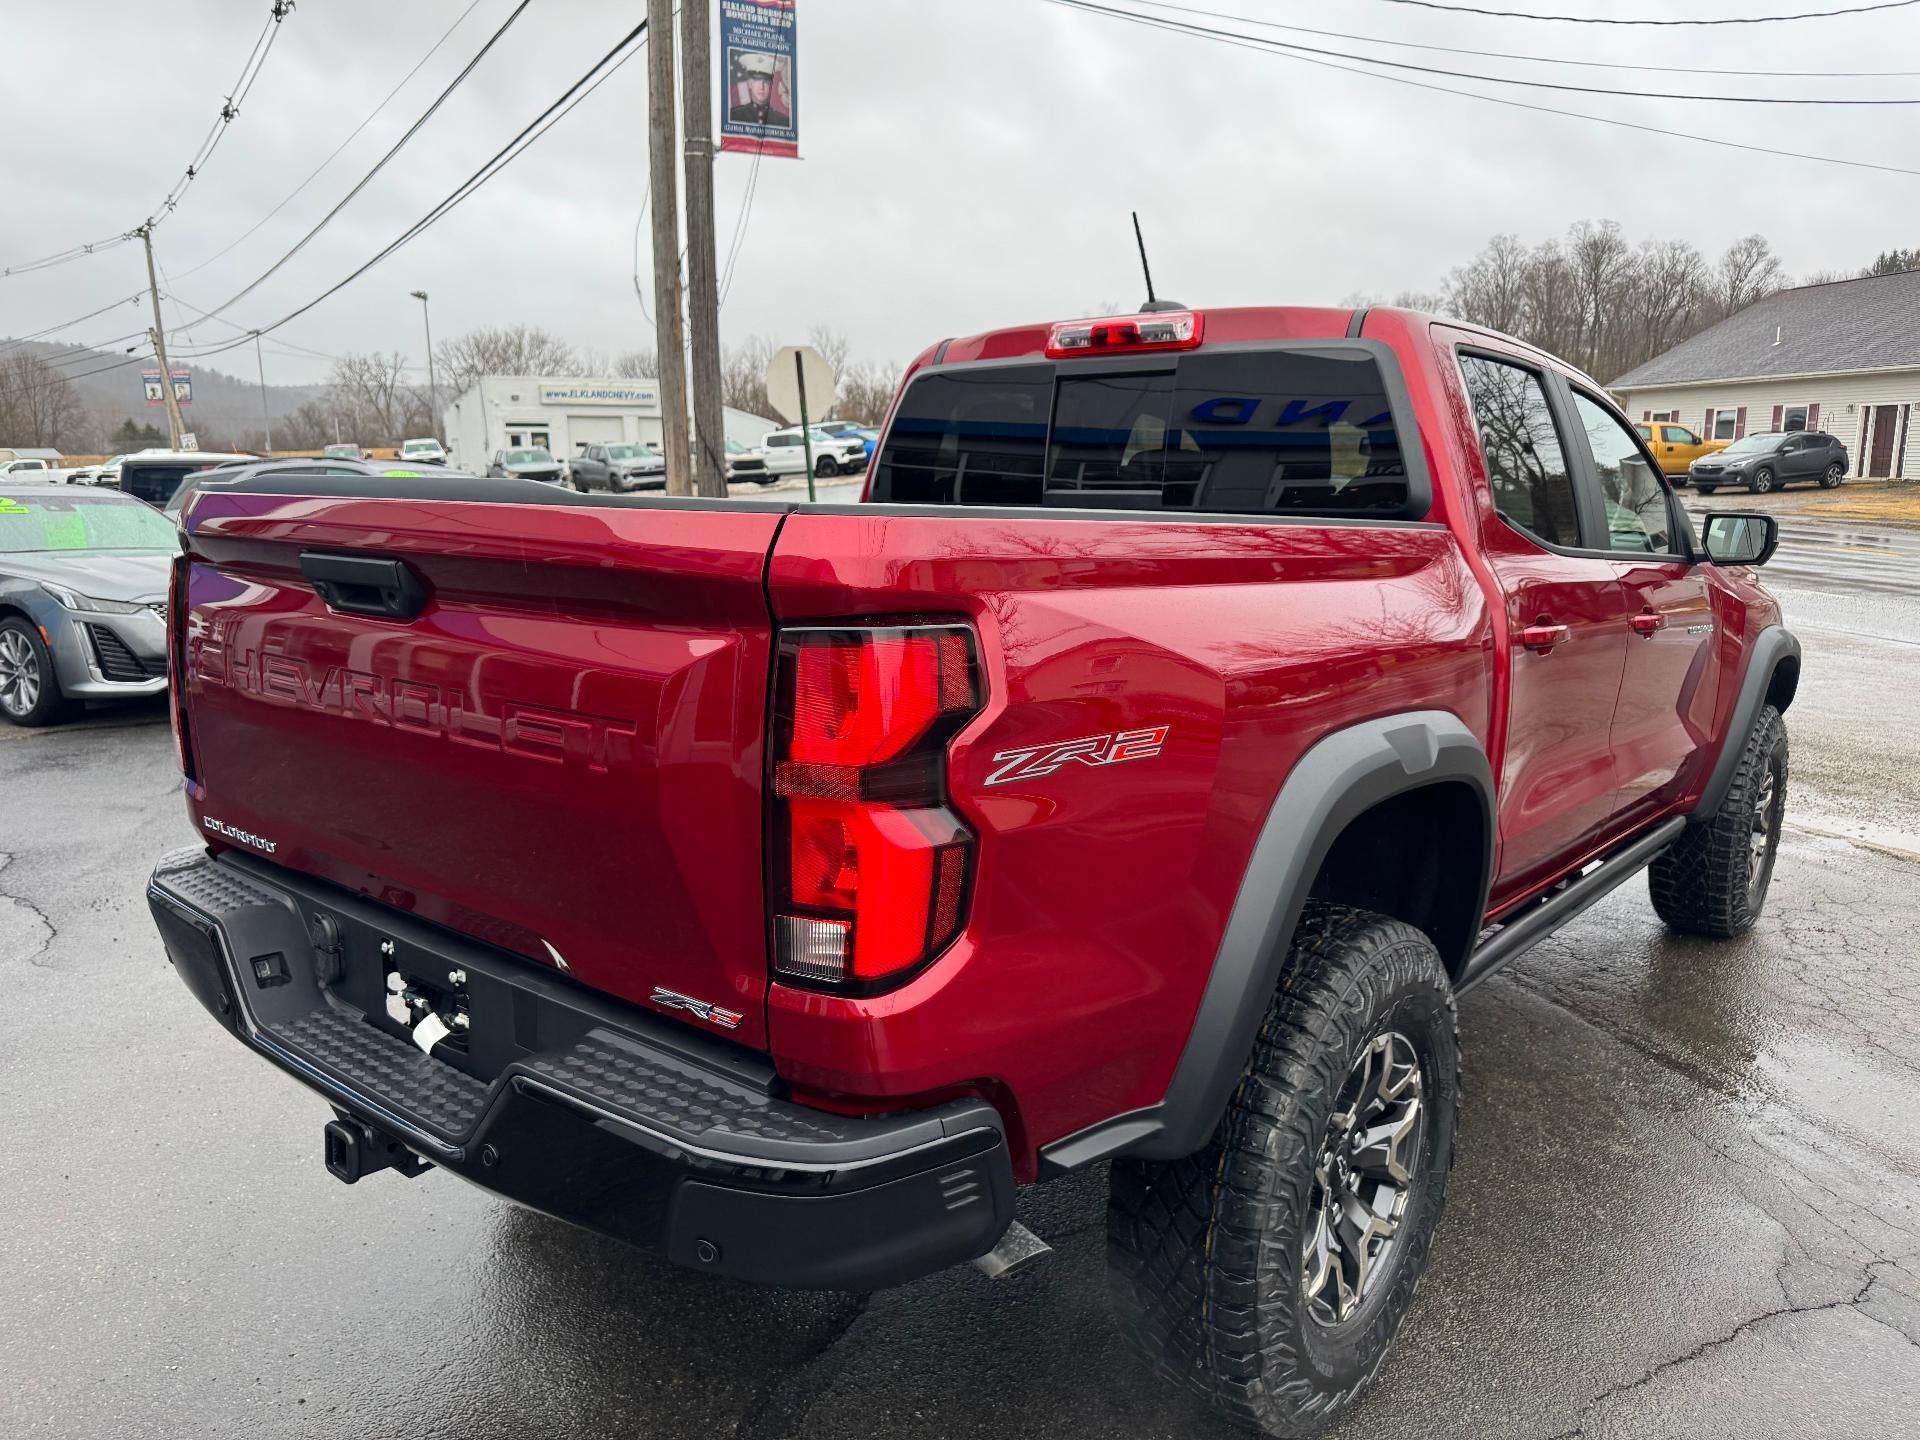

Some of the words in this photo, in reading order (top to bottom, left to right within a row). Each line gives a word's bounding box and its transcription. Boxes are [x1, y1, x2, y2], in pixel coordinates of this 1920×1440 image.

[545, 389, 654, 400] www.ELKLANDCHEVY.com
[188, 633, 637, 774] CHEVROLET
[984, 725, 1170, 786] ZR2
[203, 815, 277, 853] COLORADO
[649, 986, 744, 1029] ZR2
